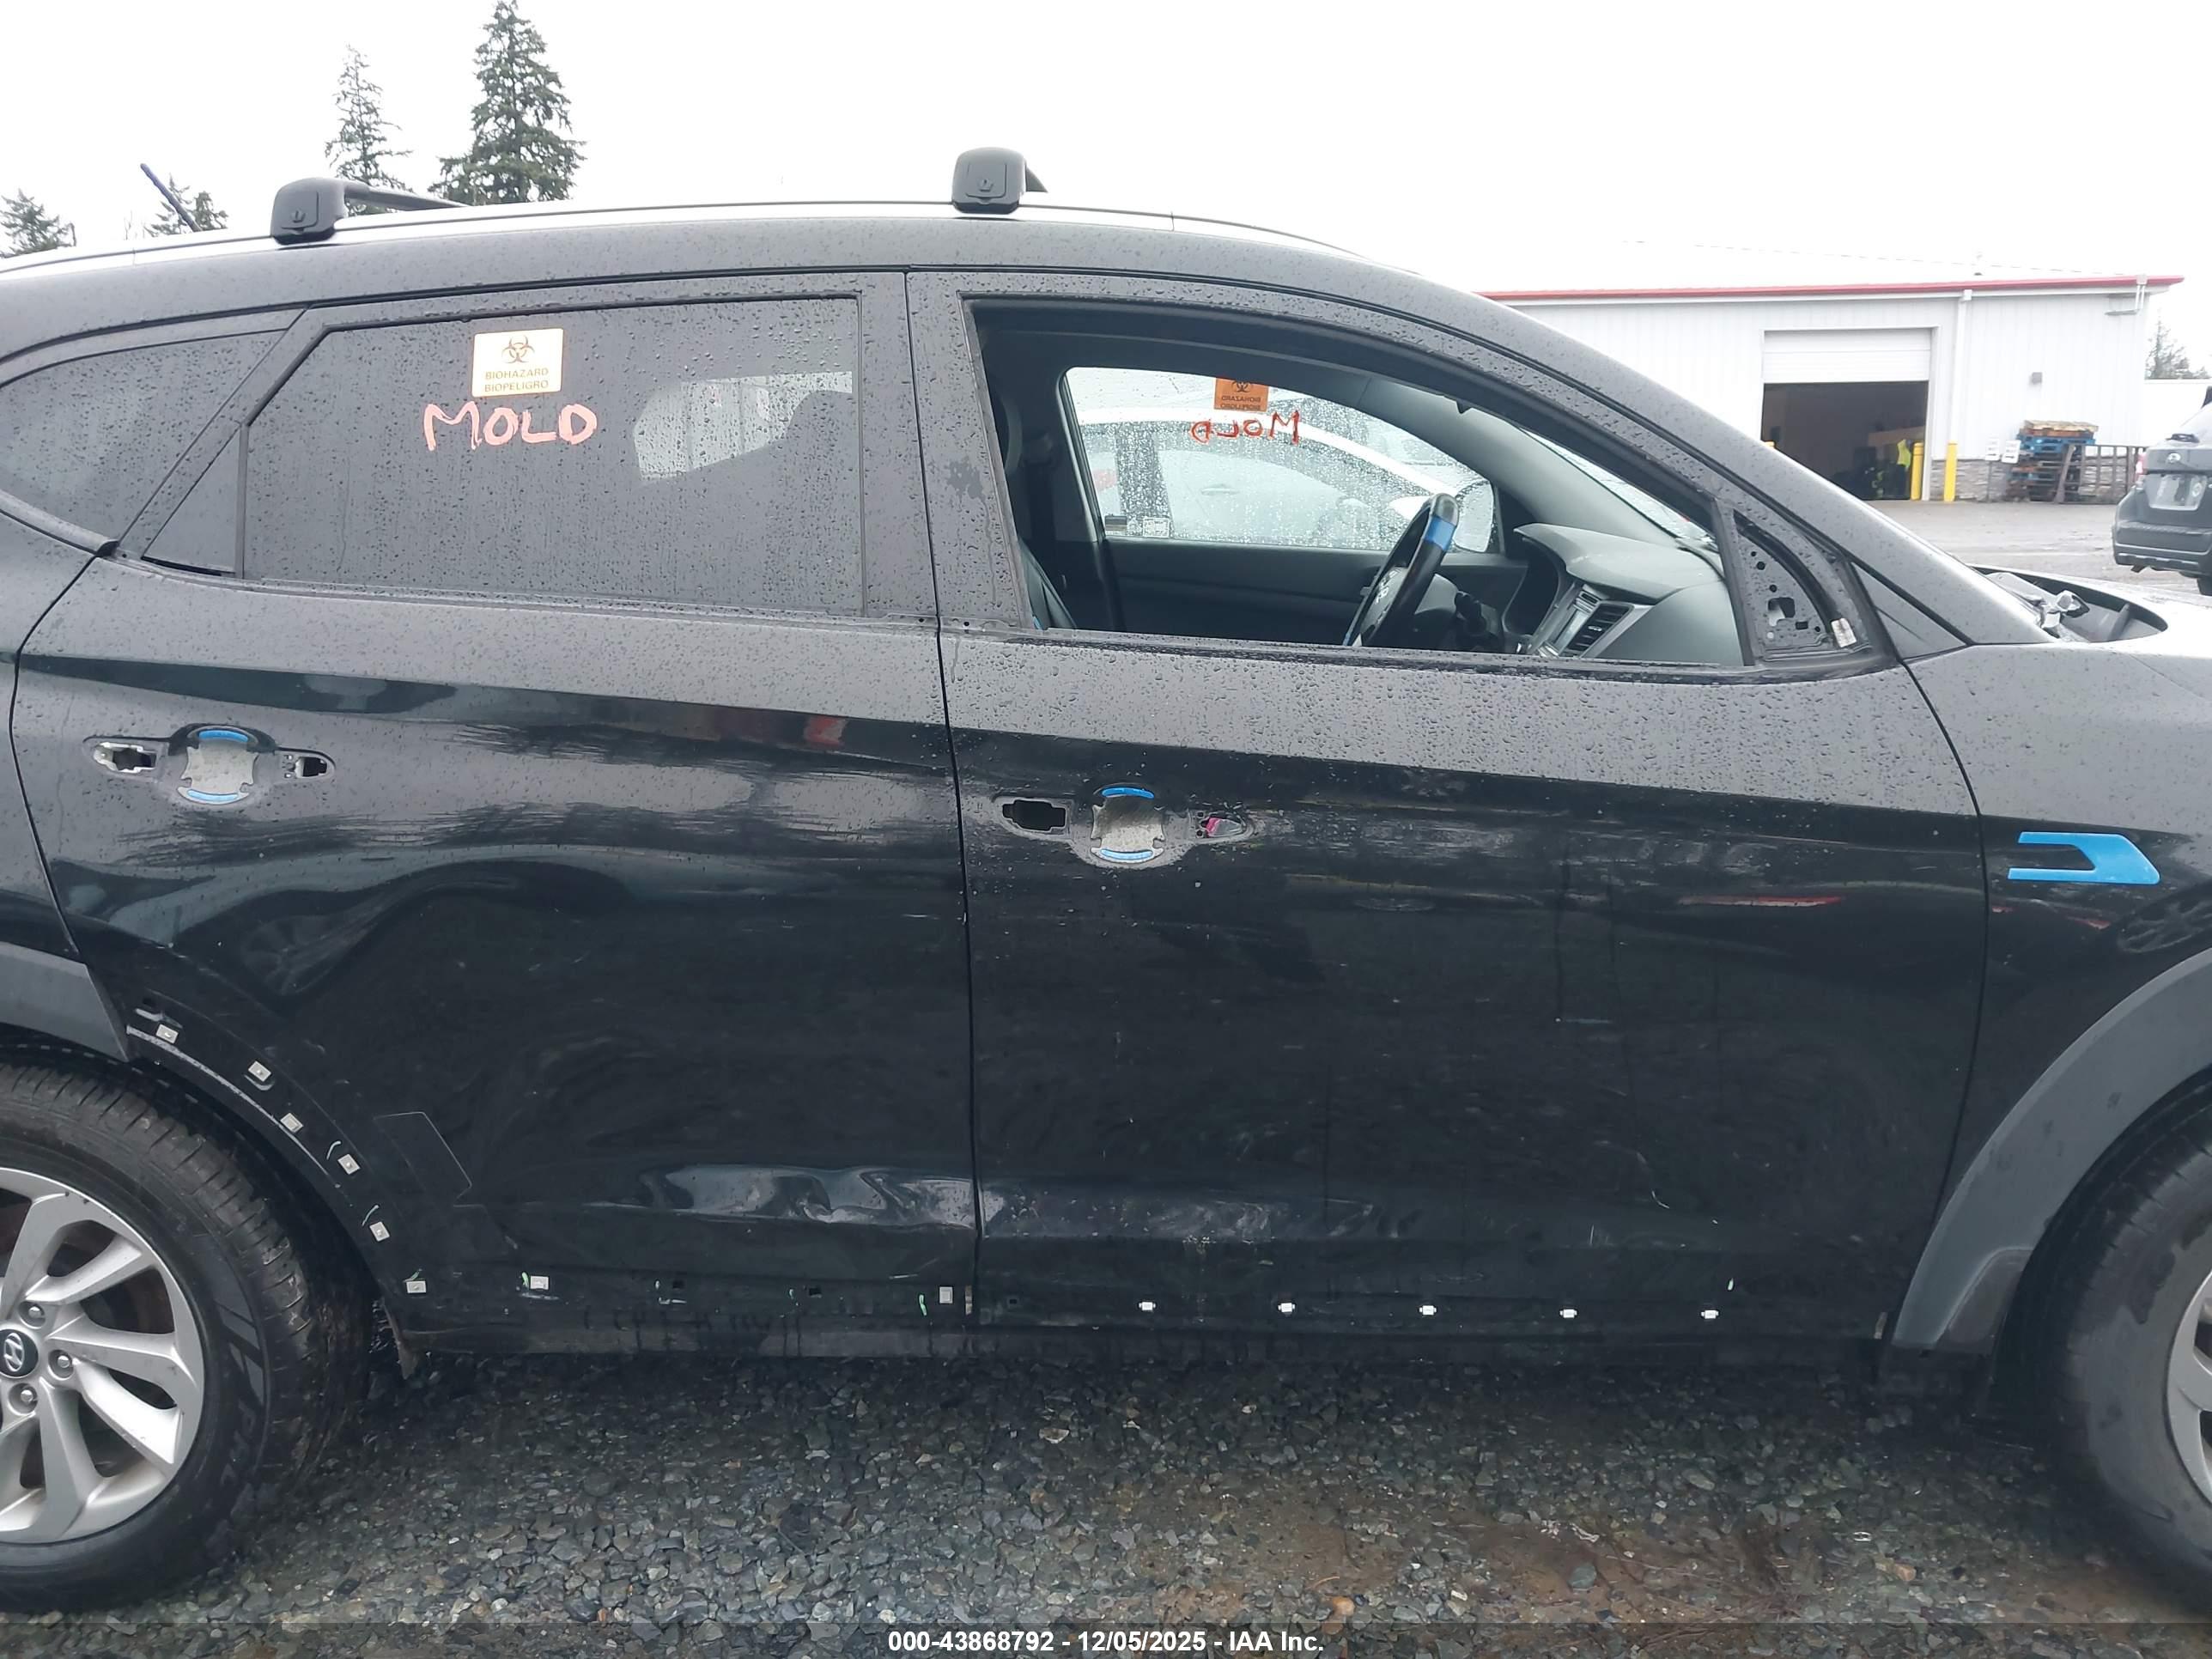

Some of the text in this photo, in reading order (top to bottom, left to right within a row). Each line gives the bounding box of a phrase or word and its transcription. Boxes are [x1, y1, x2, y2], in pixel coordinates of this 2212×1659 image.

[485, 368, 549, 380] BIOHAZARD
[484, 380, 549, 392] BIOPELIGRO
[423, 400, 598, 452] MOLD
